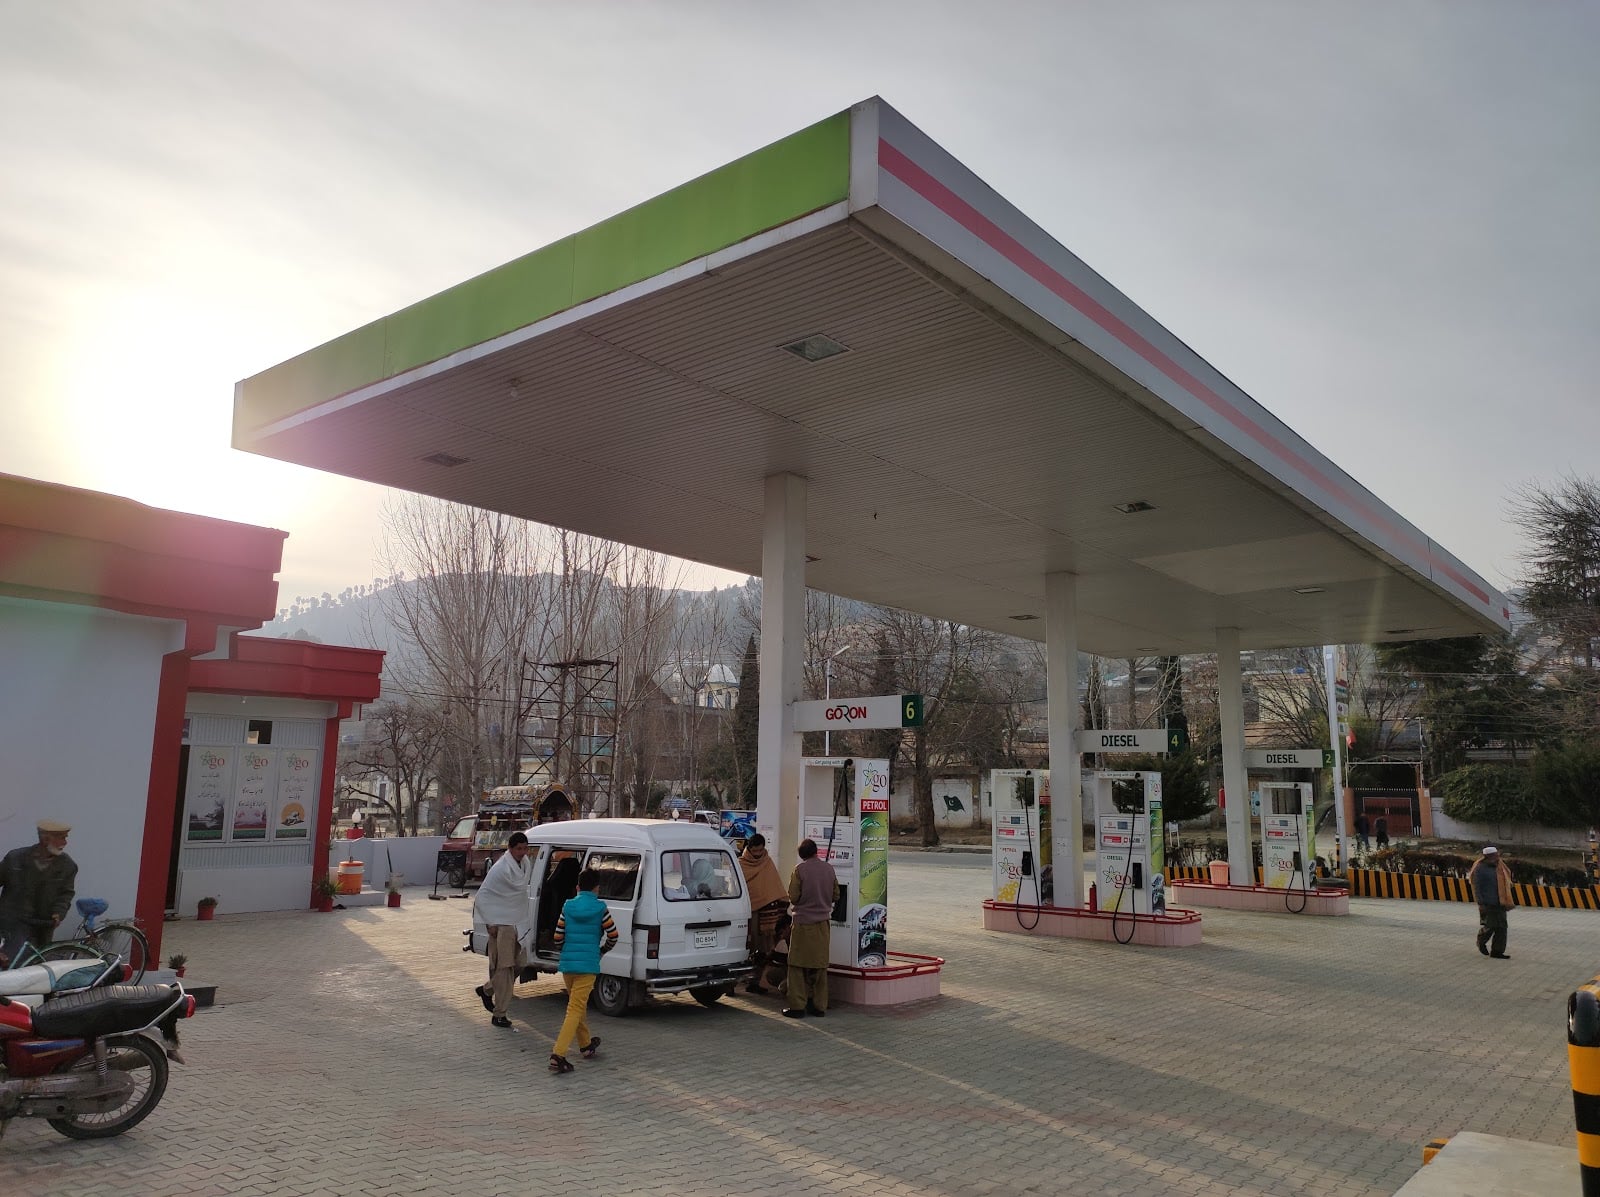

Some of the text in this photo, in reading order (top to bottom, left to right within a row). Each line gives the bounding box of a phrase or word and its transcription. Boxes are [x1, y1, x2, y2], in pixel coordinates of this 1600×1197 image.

[825, 705, 867, 723] GORON
[906, 702, 915, 719] 6
[1101, 735, 1139, 747] DIESEL
[1171, 734, 1179, 747] 4
[253, 759, 268, 770] go
[1266, 754, 1299, 764] DIESEL
[1325, 754, 1332, 763] 2
[295, 760, 309, 771] go
[873, 774, 887, 792] go
[862, 800, 887, 810] PETROL
[1114, 874, 1132, 889] go
